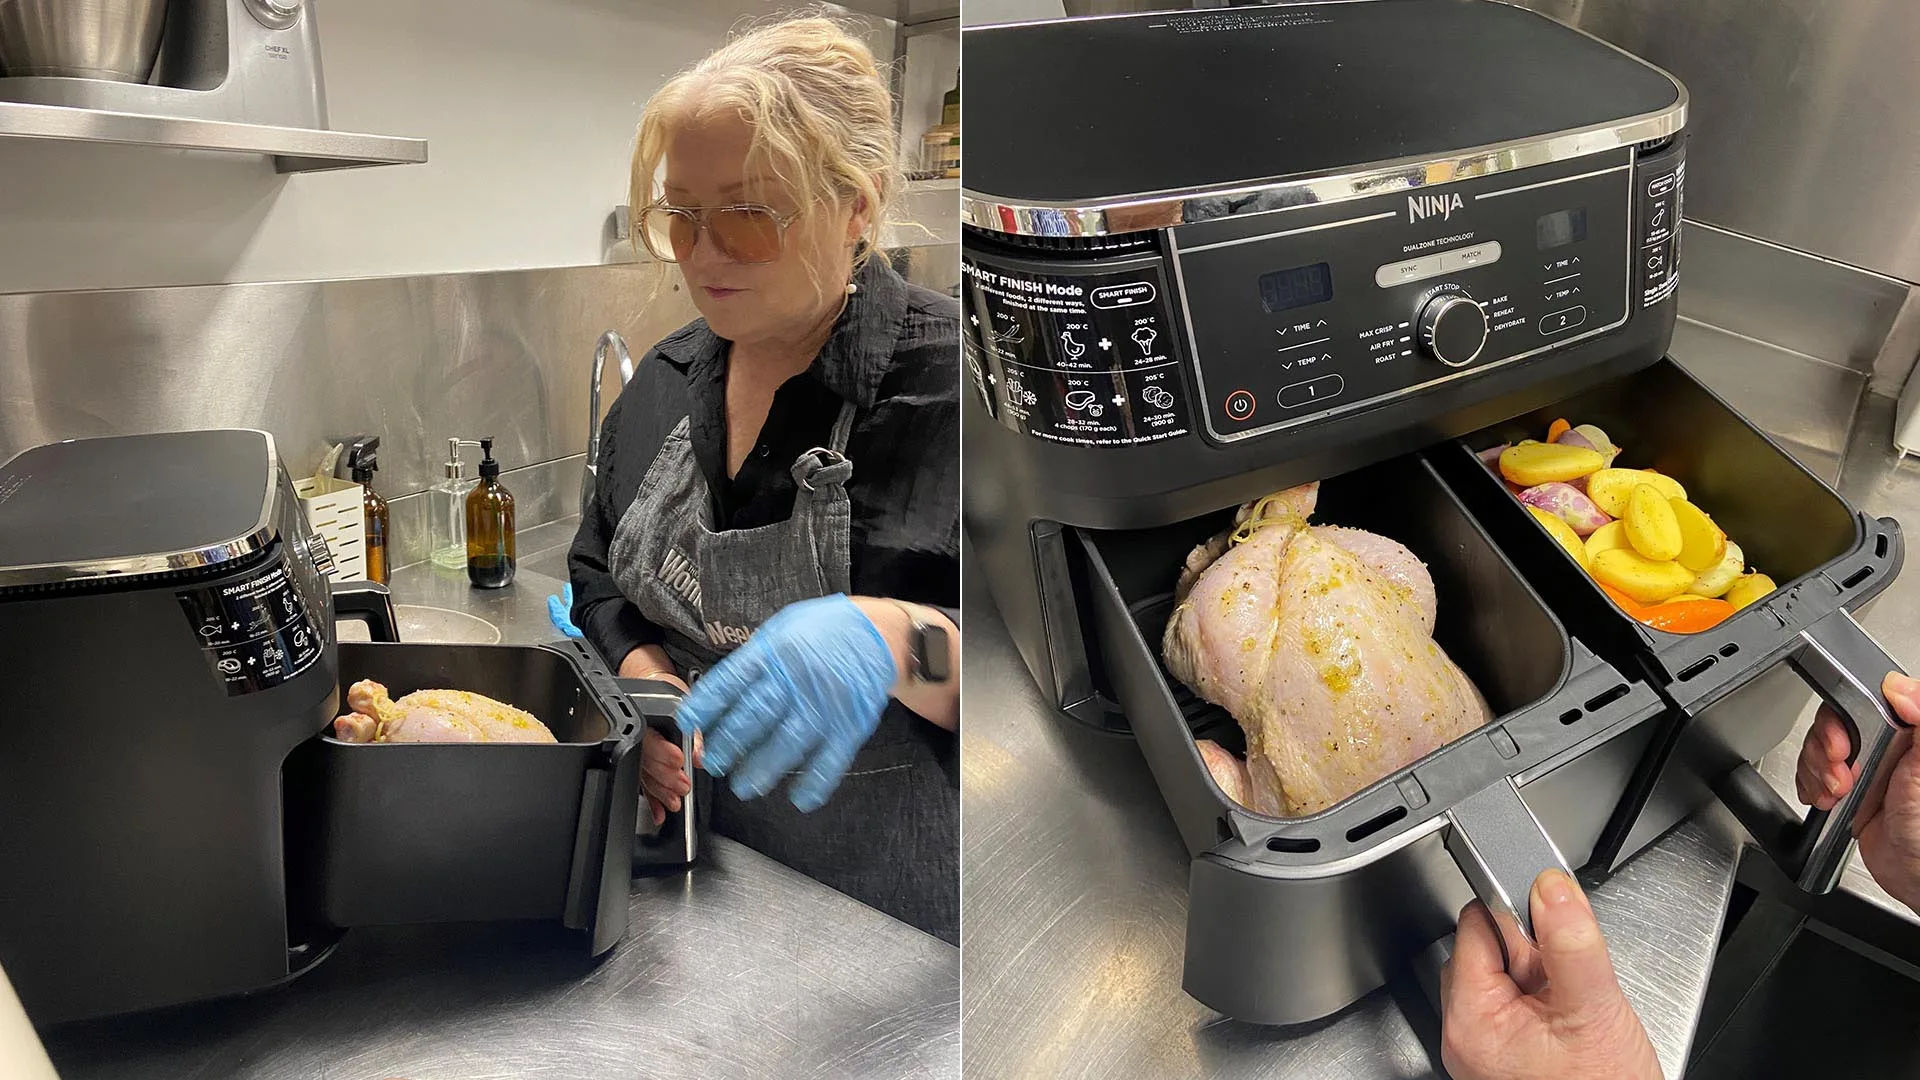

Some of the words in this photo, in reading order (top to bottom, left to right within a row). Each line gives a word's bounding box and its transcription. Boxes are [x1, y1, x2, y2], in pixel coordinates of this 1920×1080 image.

[1408, 193, 1464, 224] NINJA
[1403, 240, 1435, 252] DUALZONE
[1436, 232, 1474, 245] TECHNOLOGY
[1462, 251, 1482, 260] MATCH
[1400, 265, 1418, 274] SYNC
[962, 262, 997, 284] SMART
[1000, 276, 1042, 294] FINISH
[1046, 284, 1083, 296] Mode
[1124, 287, 1147, 295] FINISH
[1425, 285, 1443, 298] START
[1556, 290, 1569, 298] TEMP
[1003, 299, 1027, 309] finished
[1006, 292, 1026, 302] foods,
[1034, 297, 1063, 306] different
[1493, 296, 1508, 305] BAKE
[1493, 307, 1514, 318] REHEAT
[1494, 318, 1526, 332] DEHYDRATE
[1560, 316, 1566, 326] 2
[1293, 323, 1311, 332] TIME
[1359, 330, 1374, 339] MAX
[1374, 325, 1393, 336] CRISP
[1370, 342, 1381, 351] AIR
[1382, 339, 1394, 348] FRY
[1298, 356, 1316, 366] TEMP
[1375, 353, 1396, 364] ROAST
[1309, 386, 1315, 396] 1
[658, 548, 702, 607] Wom
[223, 583, 250, 596] SMART
[251, 574, 271, 588] FINISH
